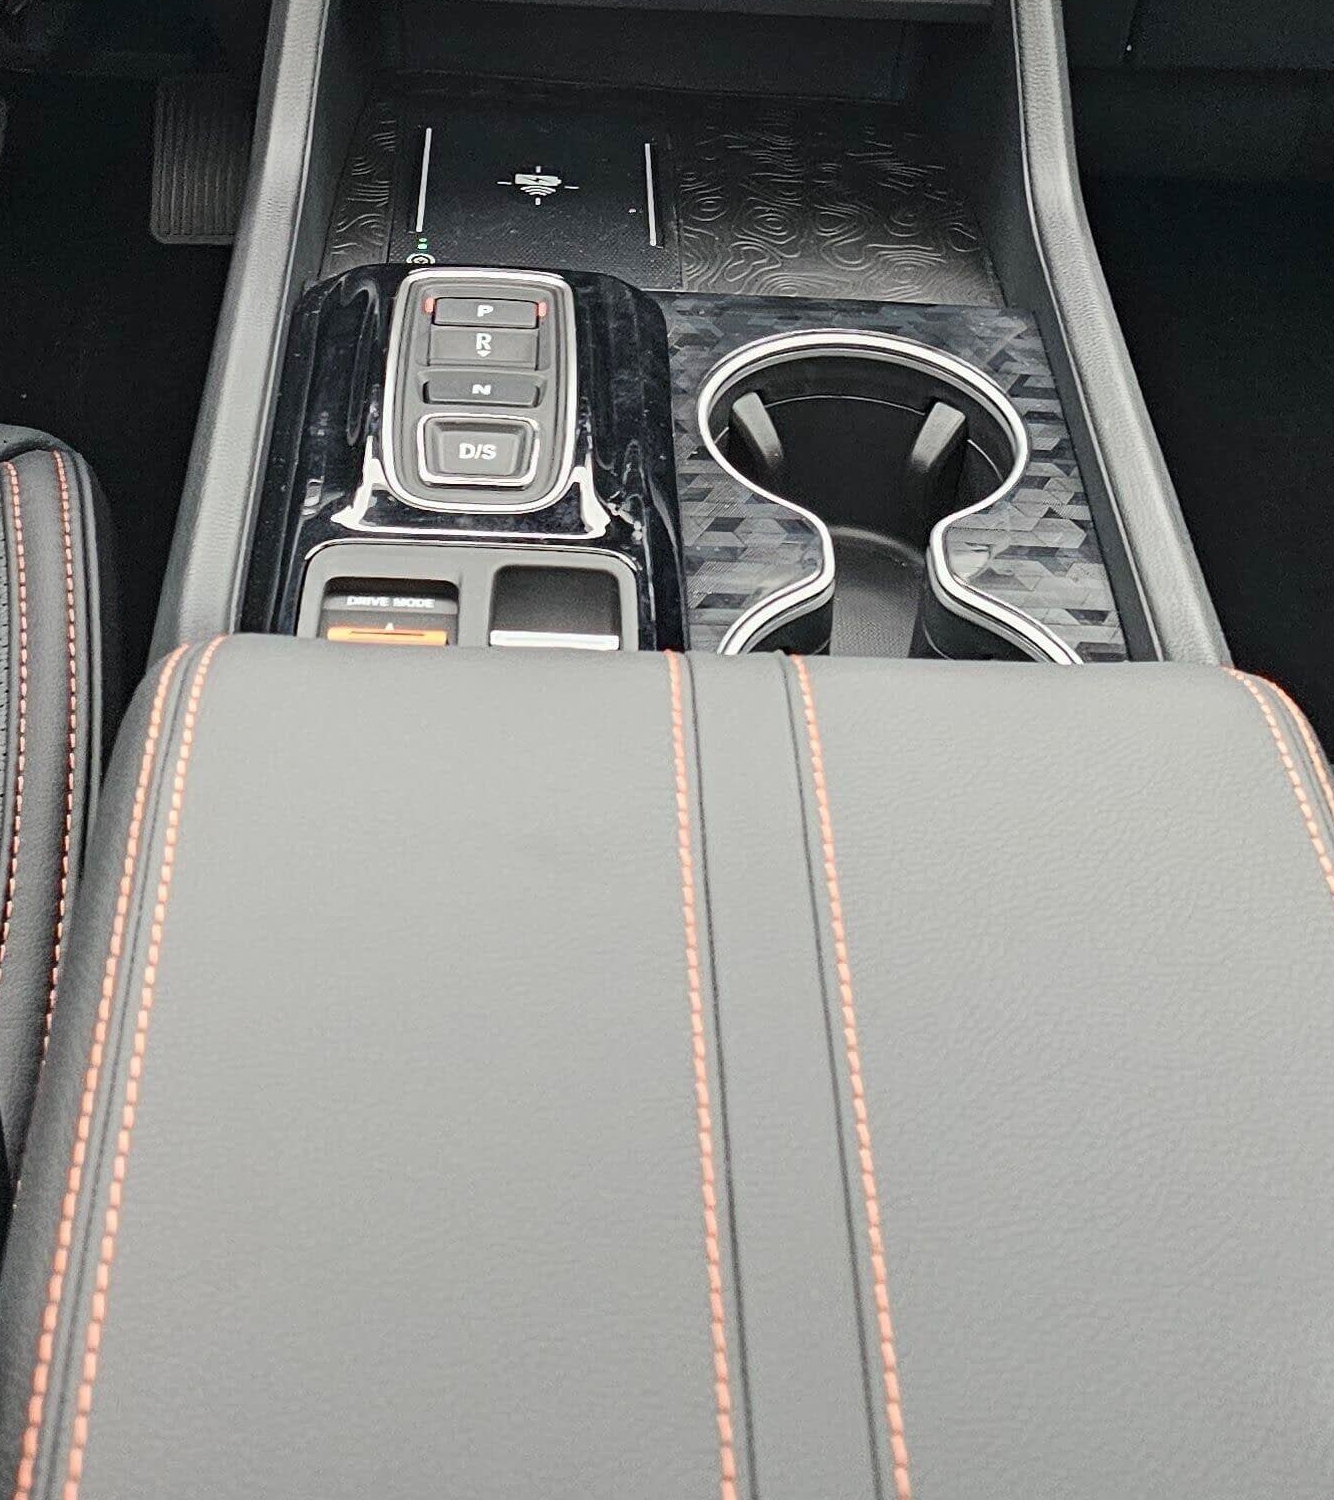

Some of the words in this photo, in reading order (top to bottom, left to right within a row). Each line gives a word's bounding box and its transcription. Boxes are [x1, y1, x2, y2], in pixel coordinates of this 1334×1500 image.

[476, 304, 495, 317] P
[474, 332, 493, 351] R
[471, 383, 492, 397] N
[457, 442, 497, 461] D/S
[347, 596, 389, 607] DRIVE
[393, 597, 436, 608] MODE
